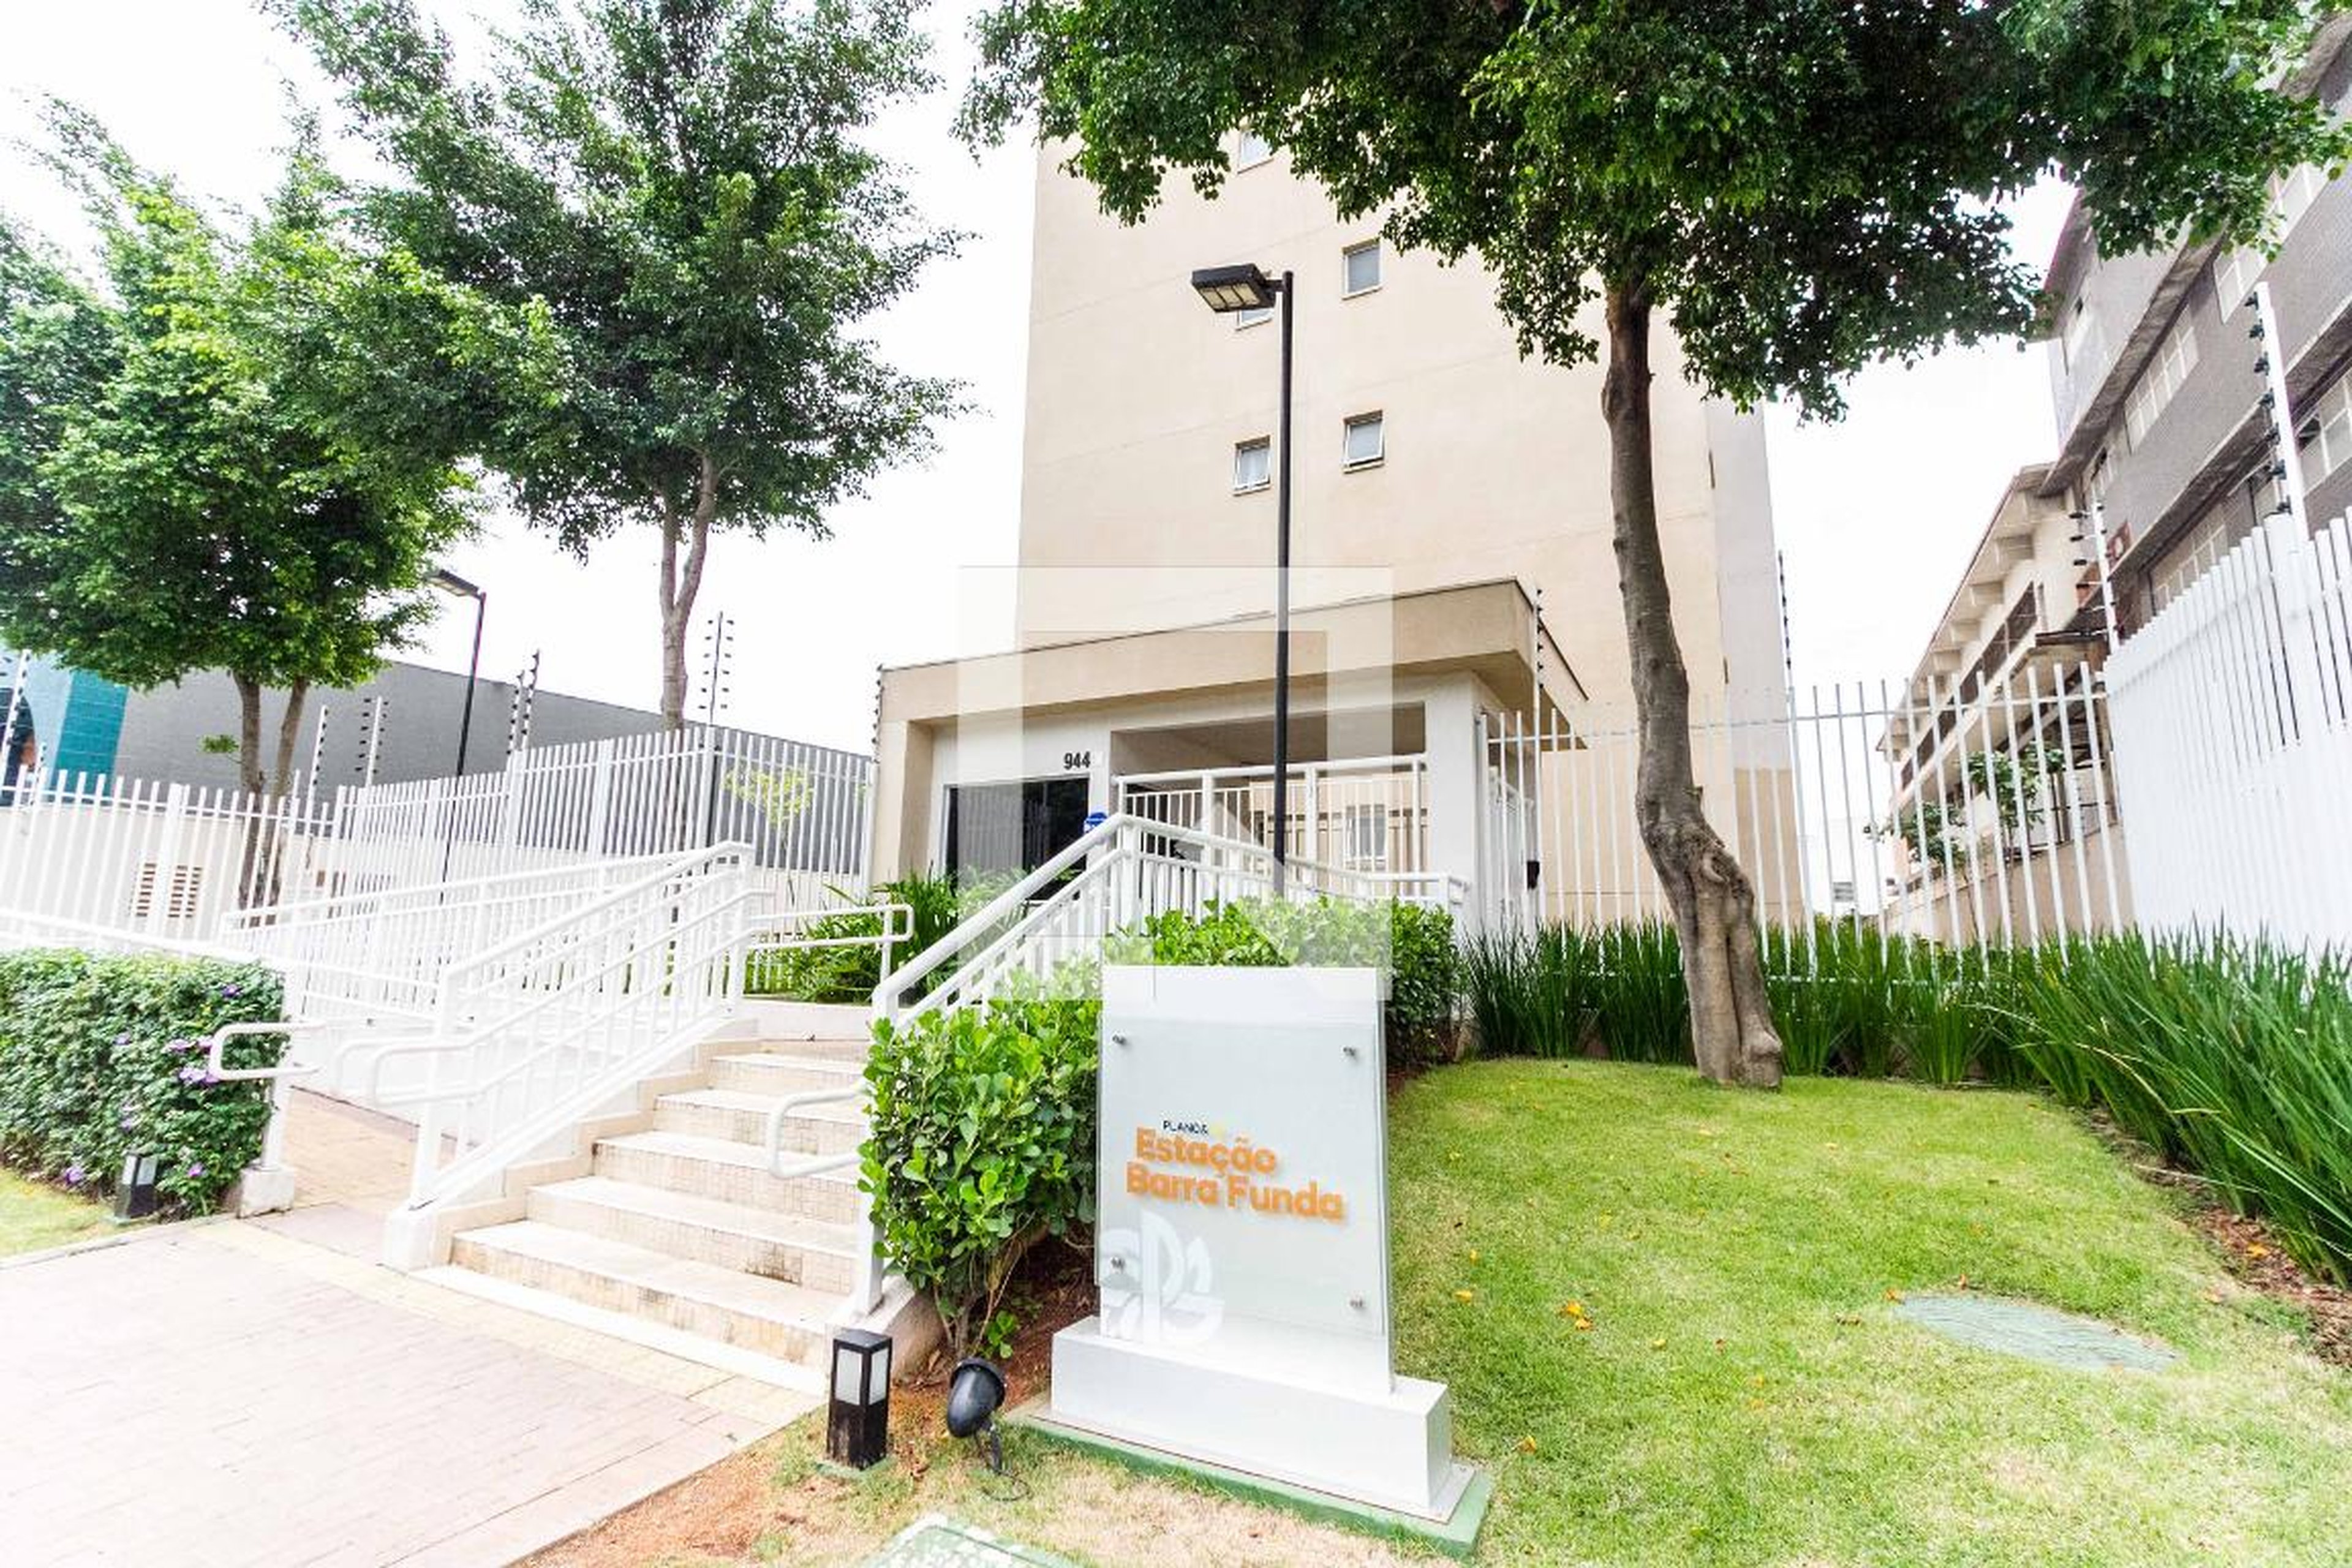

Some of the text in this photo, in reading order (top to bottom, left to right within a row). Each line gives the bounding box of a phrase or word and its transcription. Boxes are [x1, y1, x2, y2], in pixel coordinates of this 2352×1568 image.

[1063, 751, 1090, 769] 944
[1136, 1127, 1276, 1177] Estação
[1126, 1163, 1345, 1222] Barra Funda
